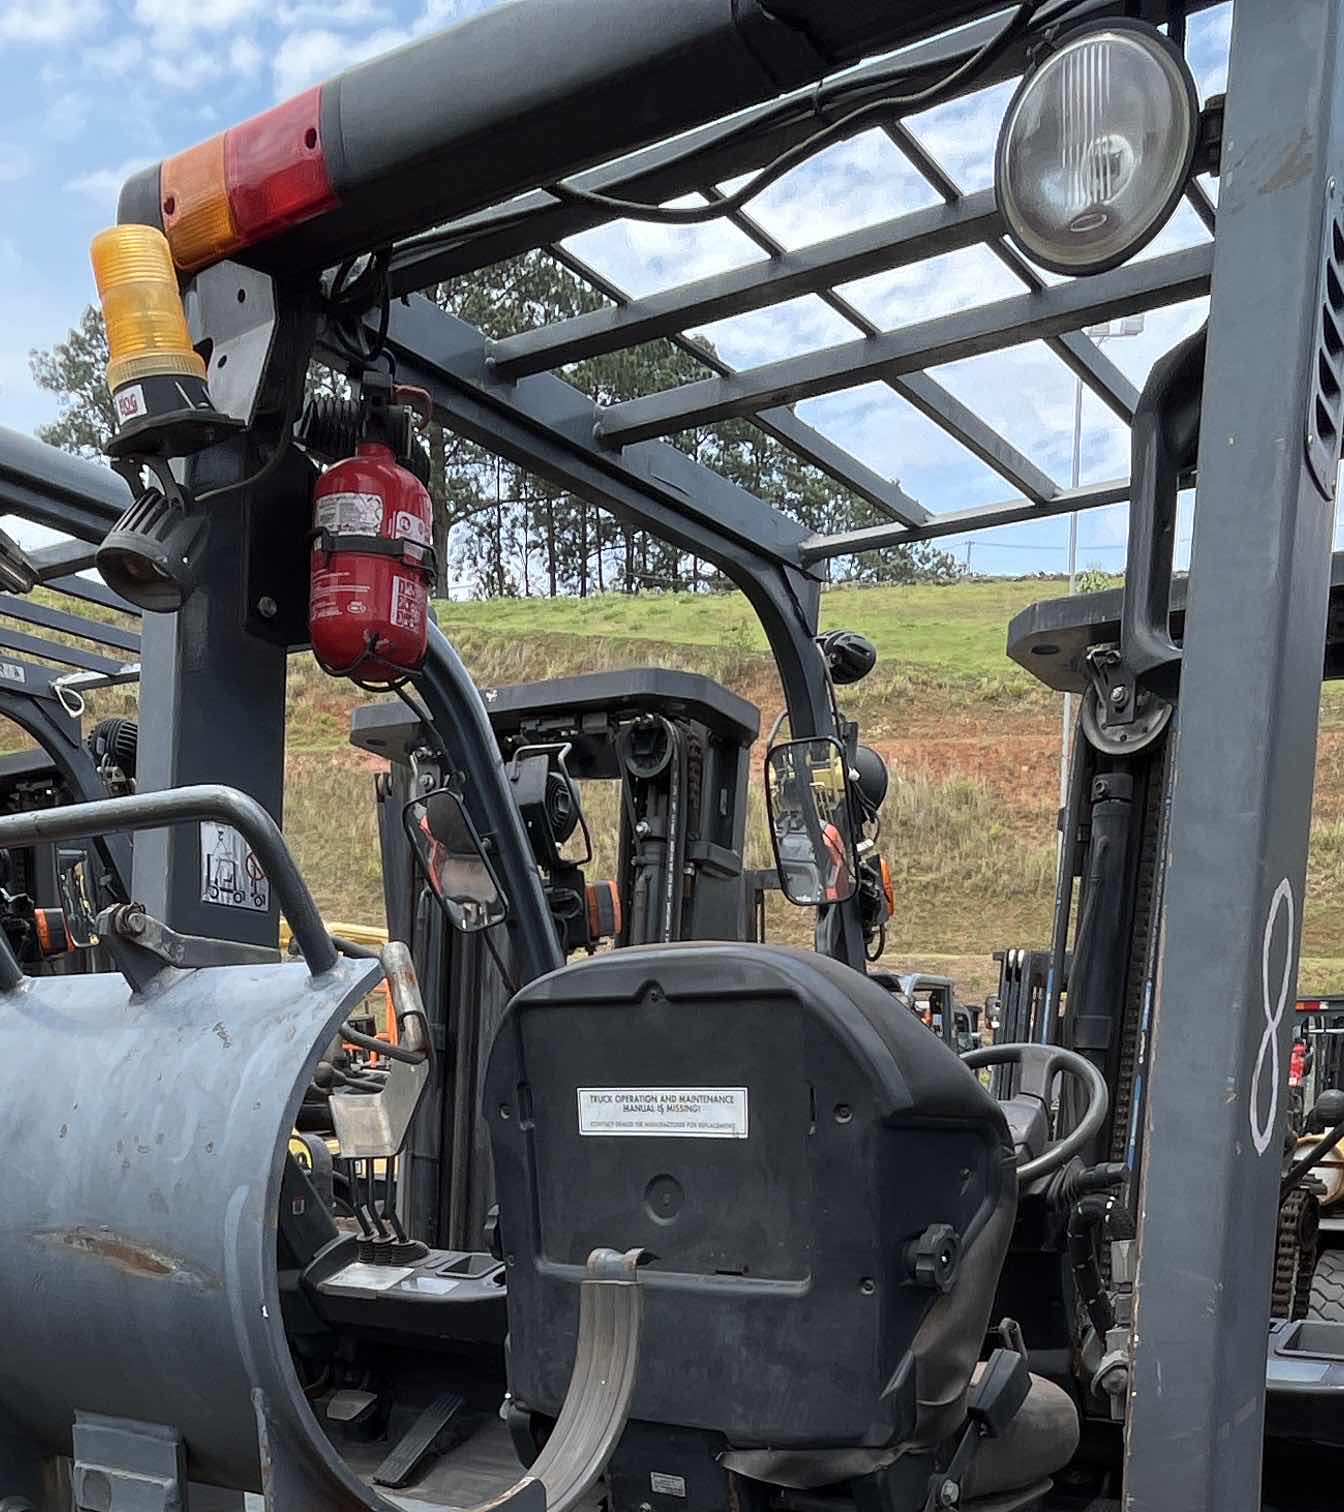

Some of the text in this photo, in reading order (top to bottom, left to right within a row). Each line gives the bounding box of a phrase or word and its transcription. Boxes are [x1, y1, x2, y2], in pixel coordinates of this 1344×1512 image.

[590, 1095, 735, 1104] TRUCK OPERATION AND MAINTENANCE
[622, 1104, 656, 1113] MANUAL
